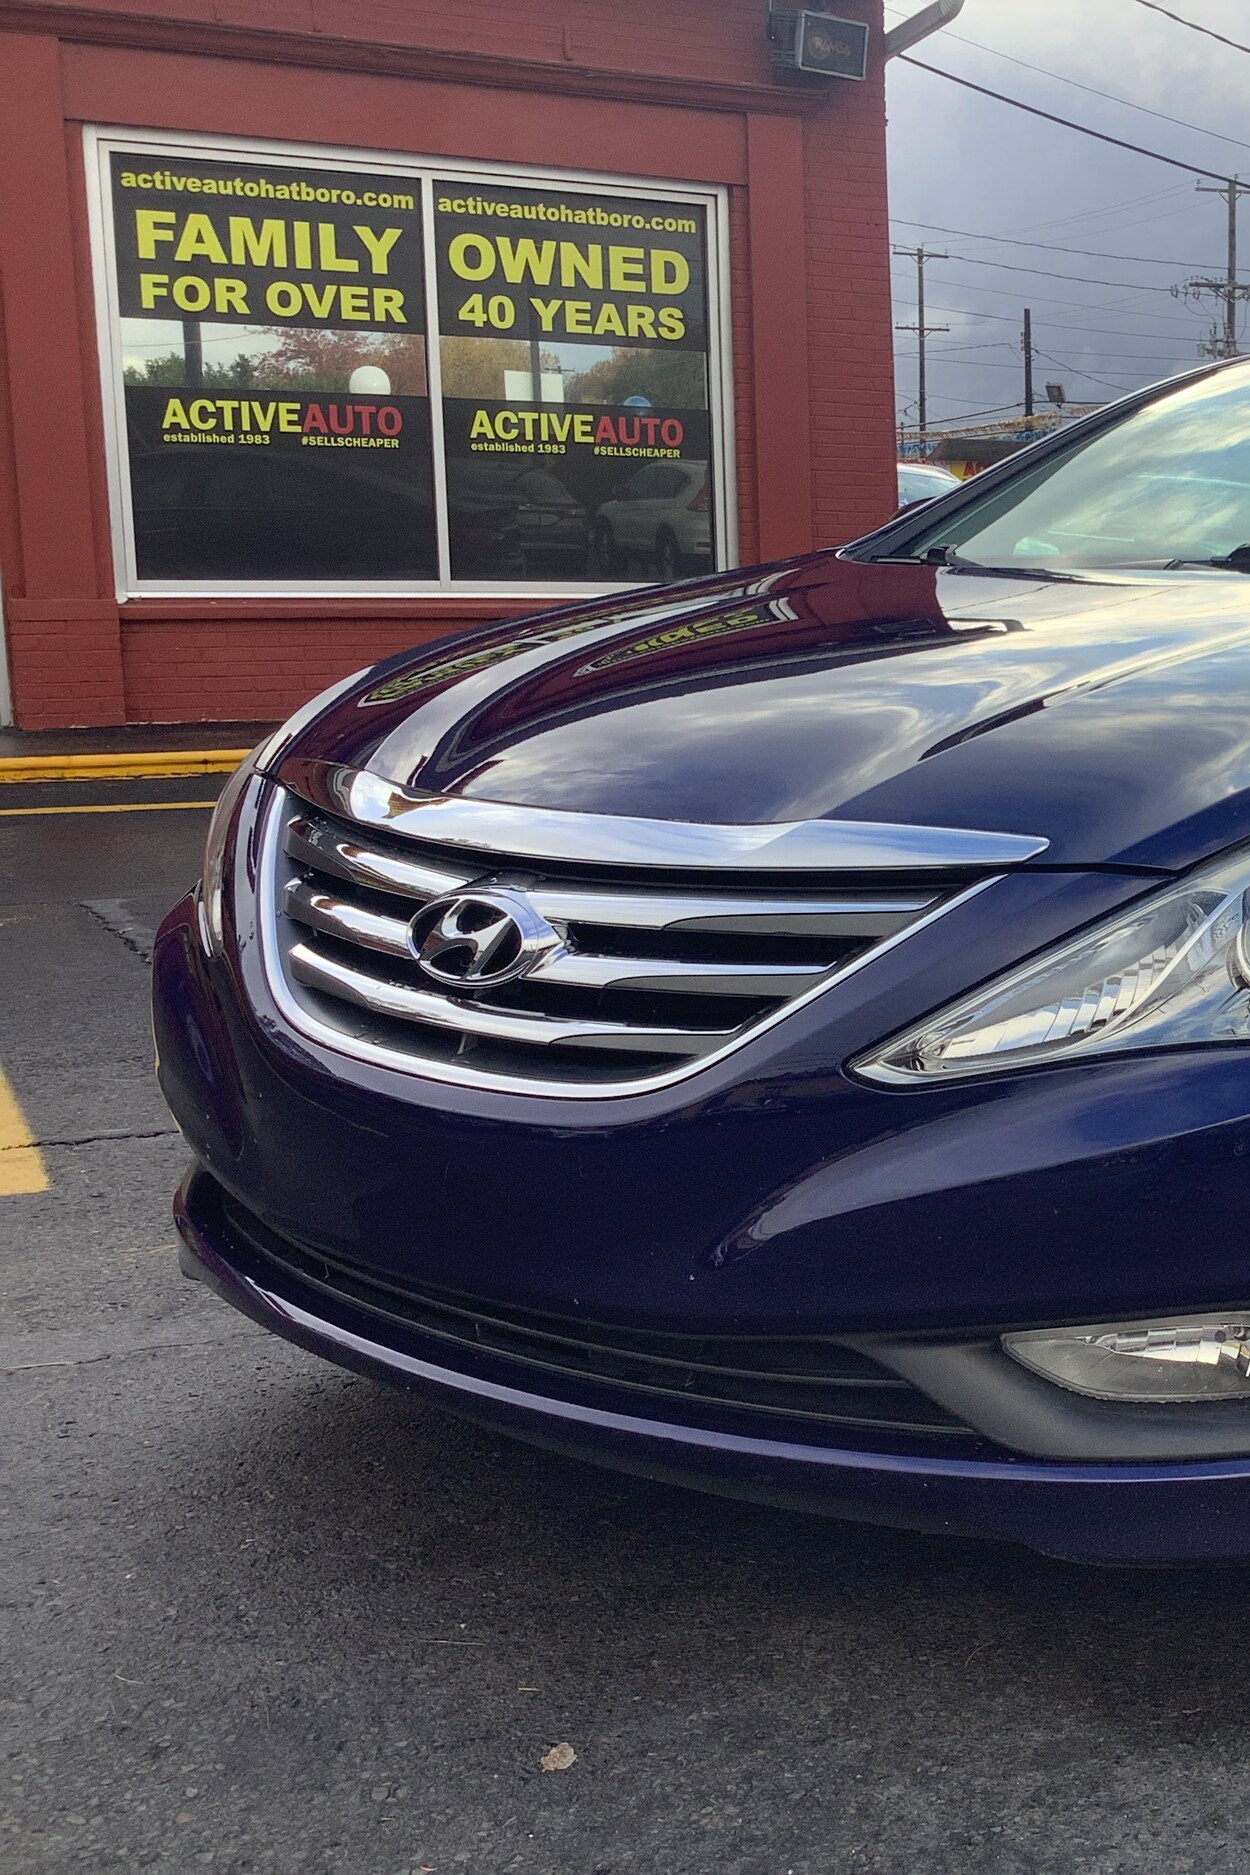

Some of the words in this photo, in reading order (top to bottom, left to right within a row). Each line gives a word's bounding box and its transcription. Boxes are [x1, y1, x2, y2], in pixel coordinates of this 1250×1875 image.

[120, 171, 414, 210] activeautohatboro.com
[438, 197, 696, 233] activeautohatboro.com
[135, 209, 403, 274] FAMILY
[449, 233, 690, 295] OWNED
[140, 273, 251, 314] FOR
[265, 281, 408, 322] OVER
[458, 293, 515, 329] 40
[530, 298, 686, 340] YEARS
[163, 433, 235, 444] established
[238, 434, 270, 444] 1983
[301, 436, 400, 449] #SELLSCHEAPER
[471, 442, 535, 453] established
[537, 444, 566, 454] 1983
[594, 446, 680, 459] #SELLSCHEAPER
